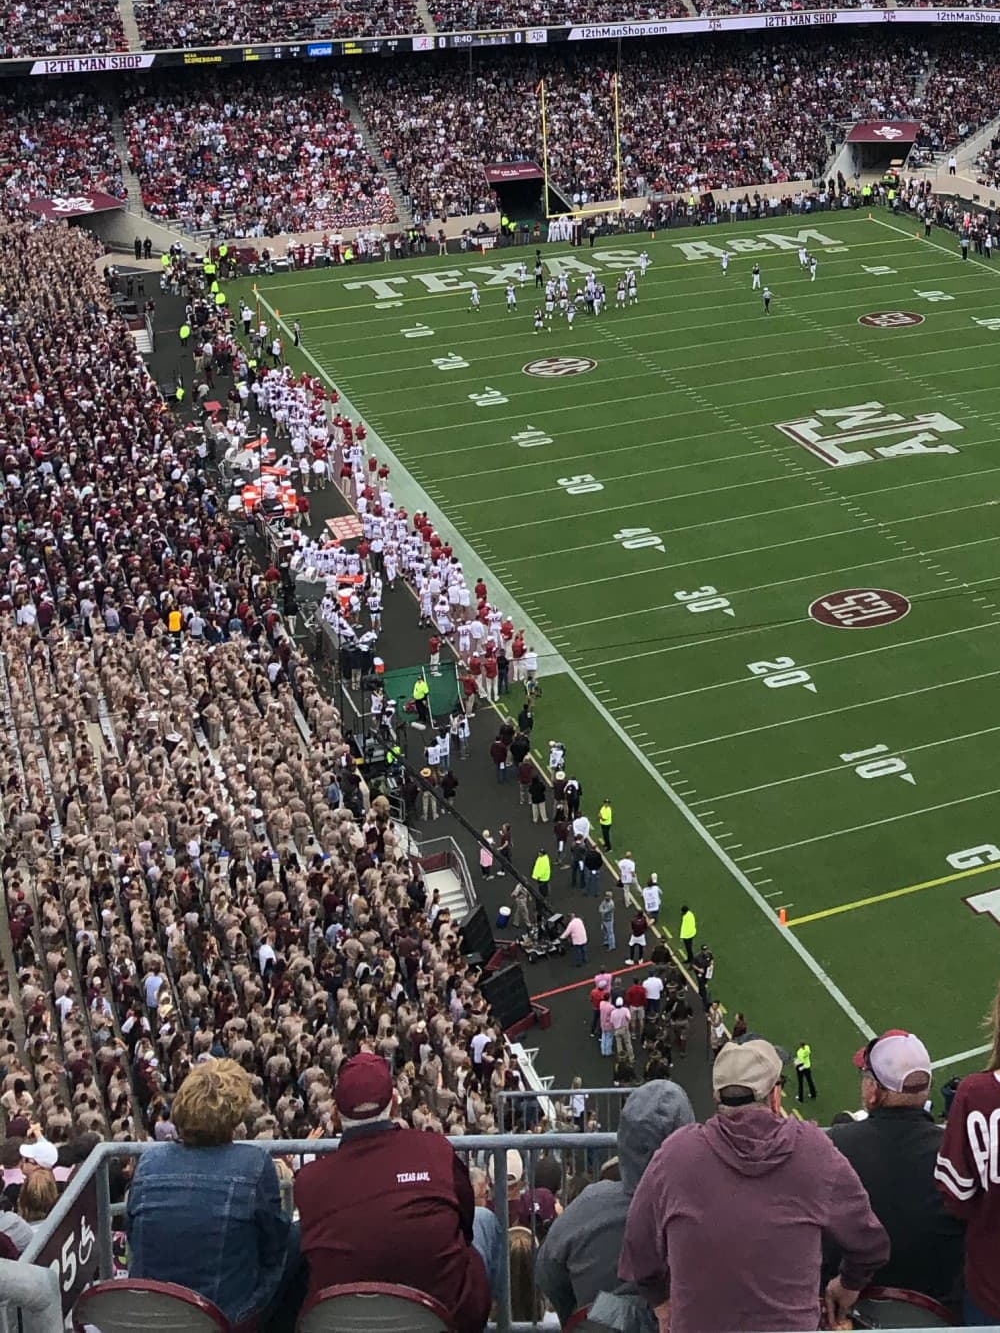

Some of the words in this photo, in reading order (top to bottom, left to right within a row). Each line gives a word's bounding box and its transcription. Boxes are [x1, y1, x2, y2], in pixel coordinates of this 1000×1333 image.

[765, 16, 787, 27] 12TH
[790, 15, 812, 26] MAN
[814, 13, 837, 25] SHOP
[439, 37, 446, 48] 0
[454, 35, 472, 43] 8:40
[515, 32, 521, 43] 0
[581, 25, 668, 39] 12thManShop.com
[44, 59, 75, 73] 12TH
[79, 57, 106, 71] MAN
[111, 56, 143, 70] SHOP
[671, 228, 845, 262] A&M
[343, 249, 654, 300] TEXAS
[864, 265, 898, 276] 10
[917, 289, 955, 303] 20
[400, 325, 434, 339] 10
[431, 355, 470, 370] 20
[468, 390, 509, 407] 30
[511, 430, 553, 448] 40
[556, 473, 604, 495] 50
[612, 527, 664, 550] 40
[674, 585, 731, 613] 30
[746, 656, 812, 688] 20
[839, 743, 908, 779] 10
[396, 1172, 416, 1183] TEXAS
